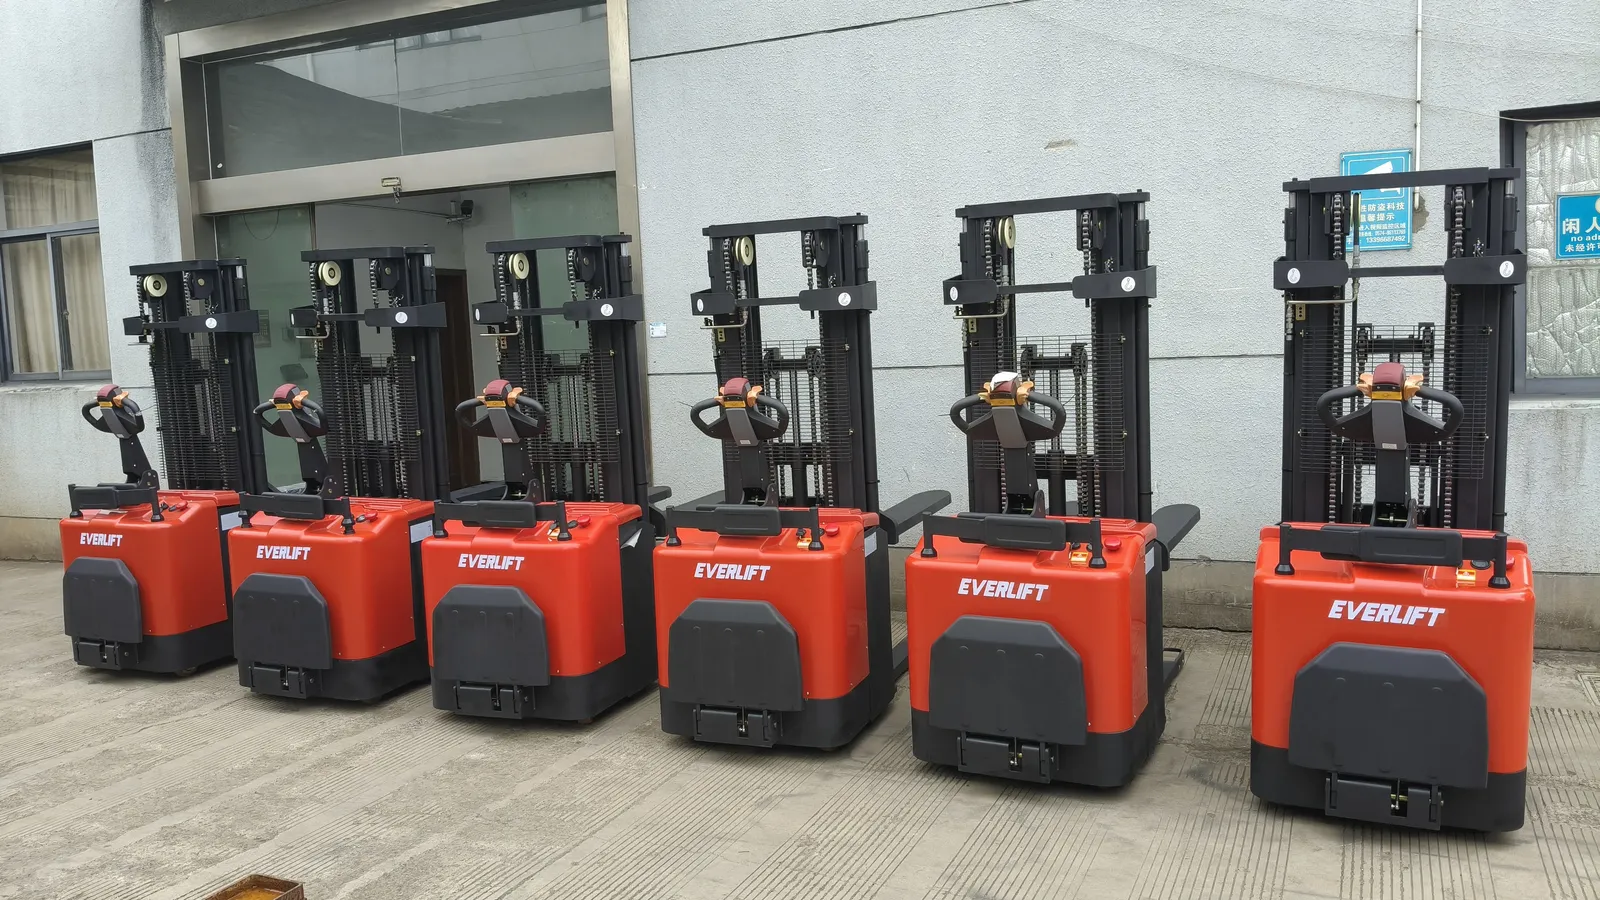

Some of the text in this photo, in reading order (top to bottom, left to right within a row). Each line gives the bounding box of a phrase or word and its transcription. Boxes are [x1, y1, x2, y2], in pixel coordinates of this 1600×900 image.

[1562, 217, 1600, 235] 闲人
[80, 533, 123, 547] EVERLIFT
[256, 545, 311, 560] EVERLIFT
[458, 554, 525, 570] EVERLIFT
[694, 563, 771, 581] EVERLIFT
[958, 578, 1049, 601] EVERLIFT
[1328, 600, 1446, 626] EVERLIFT
